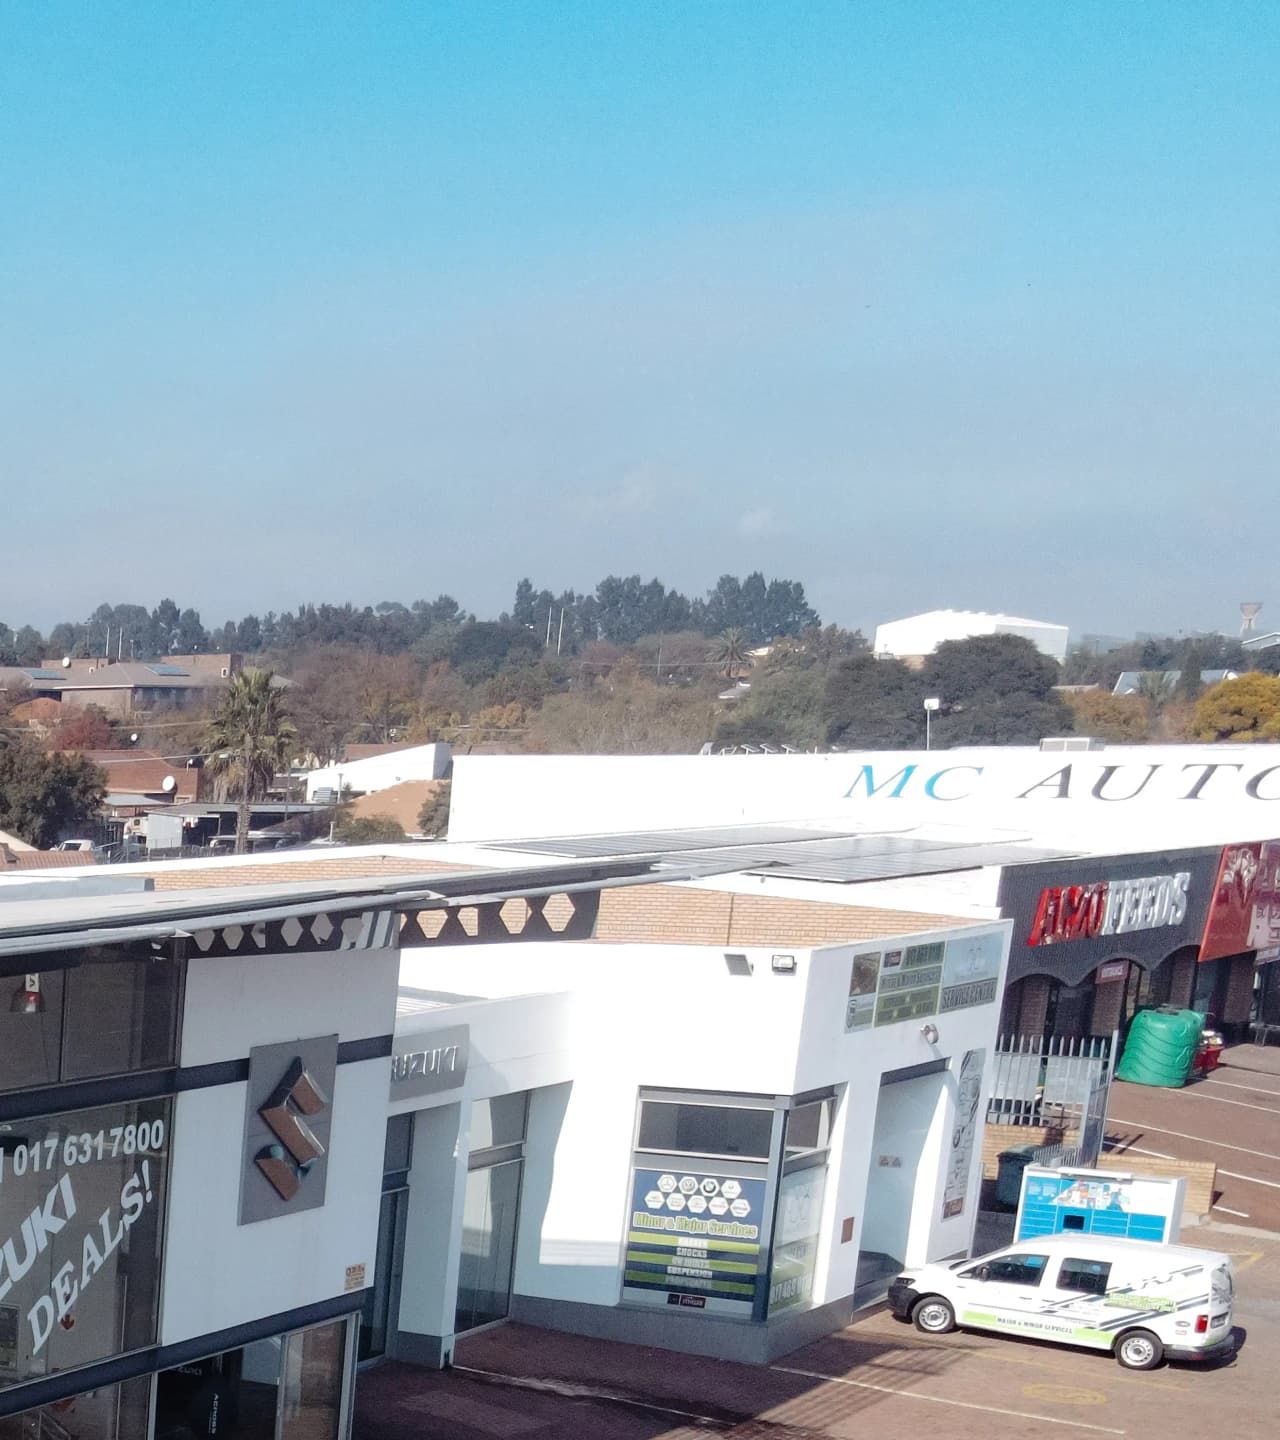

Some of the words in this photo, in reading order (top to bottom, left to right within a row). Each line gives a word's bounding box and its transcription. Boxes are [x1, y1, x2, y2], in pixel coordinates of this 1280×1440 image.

[842, 764, 985, 801] MC
[392, 1045, 459, 1081] UZUKI
[13, 1138, 60, 1176] 017
[27, 1160, 153, 1356] DEALS!
